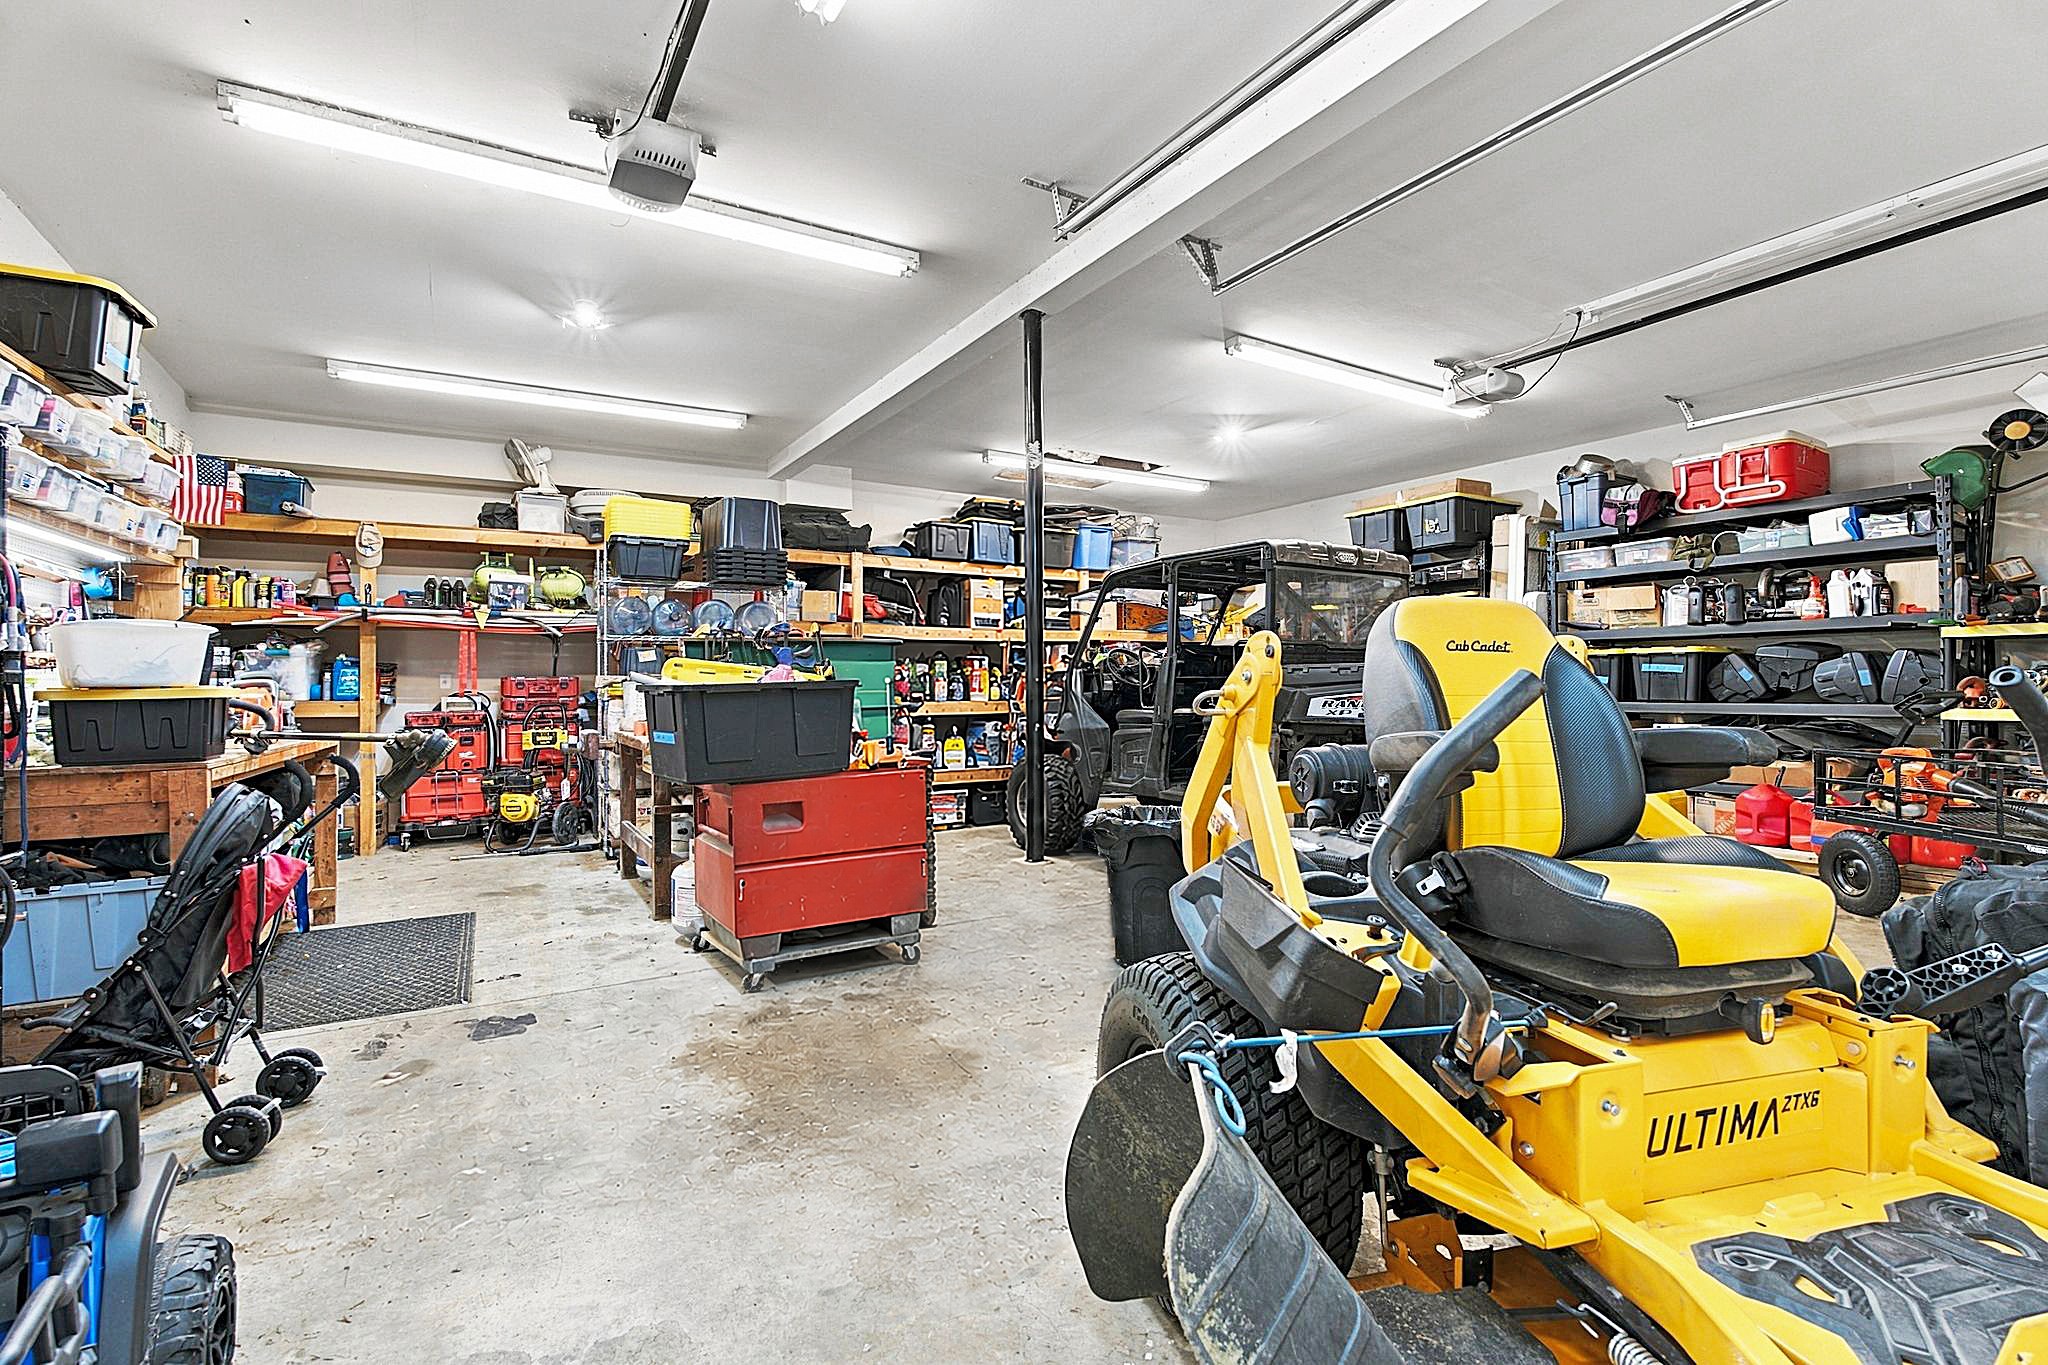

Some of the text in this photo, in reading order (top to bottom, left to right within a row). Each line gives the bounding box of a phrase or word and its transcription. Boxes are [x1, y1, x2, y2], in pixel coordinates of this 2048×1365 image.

[1446, 640, 1512, 653] Cub Cadet
[1321, 699, 1364, 709] RAN
[1646, 1090, 1821, 1159] ULTIMA ZTX6
